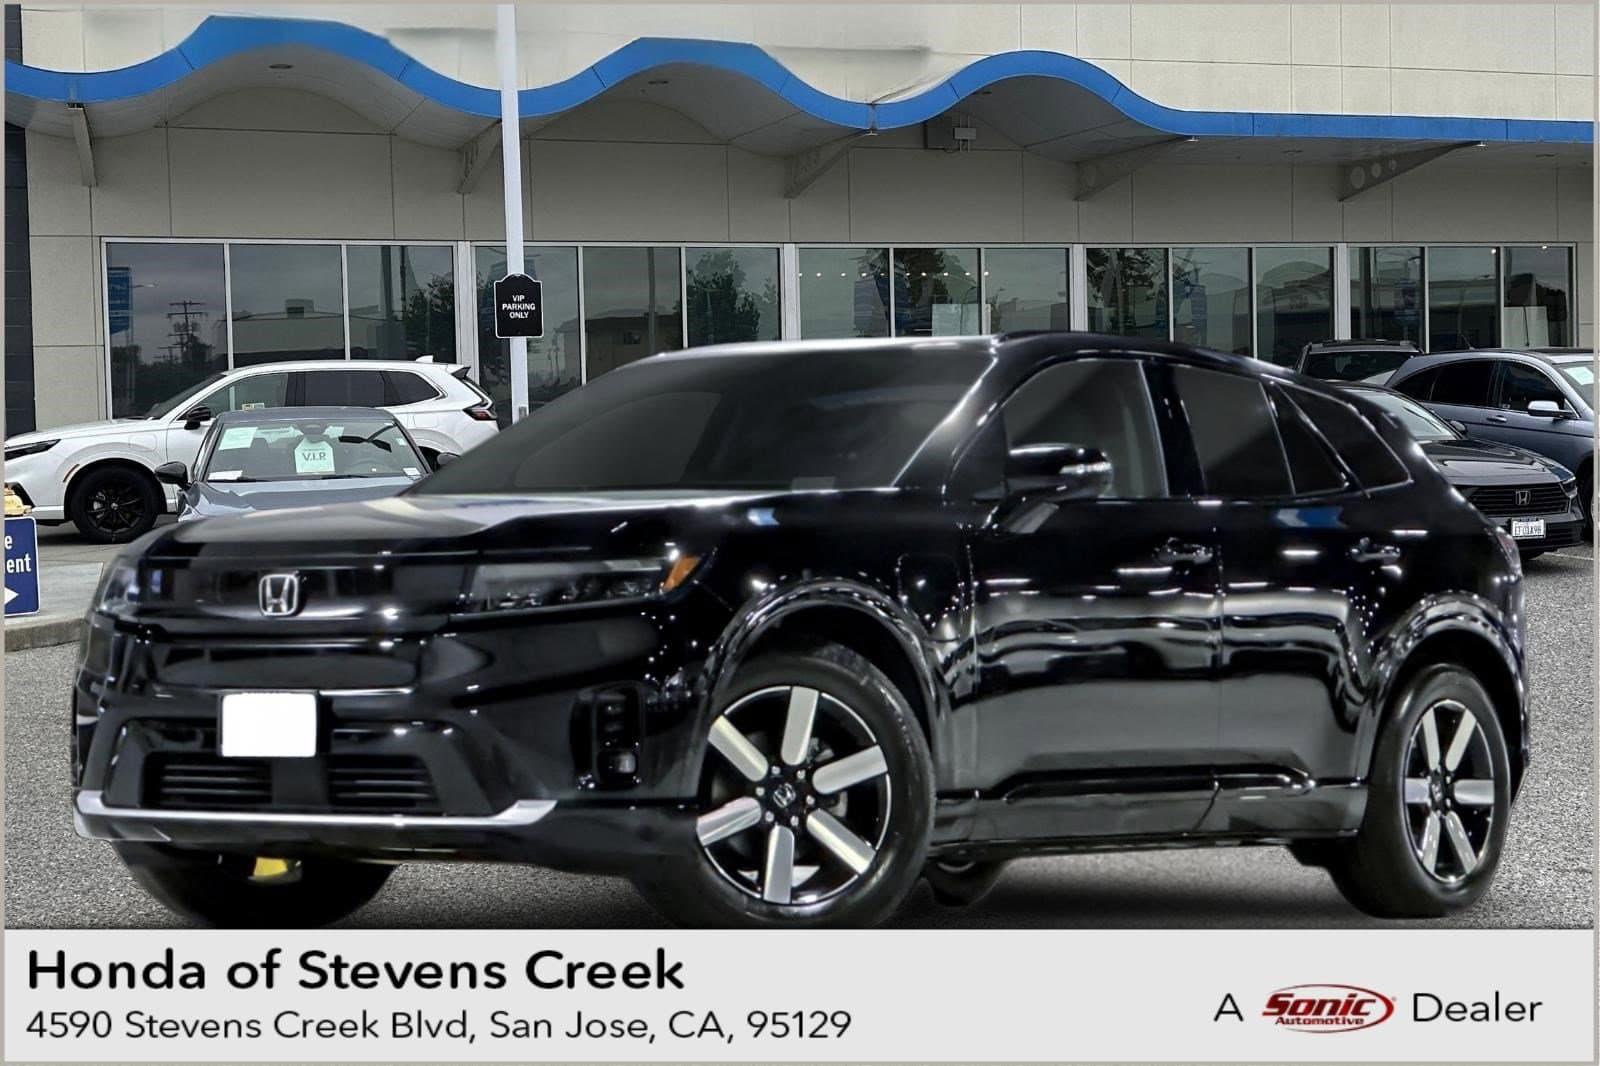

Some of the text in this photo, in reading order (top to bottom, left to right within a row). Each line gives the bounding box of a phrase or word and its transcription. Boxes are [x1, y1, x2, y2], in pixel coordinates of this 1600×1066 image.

[512, 294, 525, 302] VIP
[502, 303, 536, 311] PARKING
[509, 311, 529, 319] ONLY
